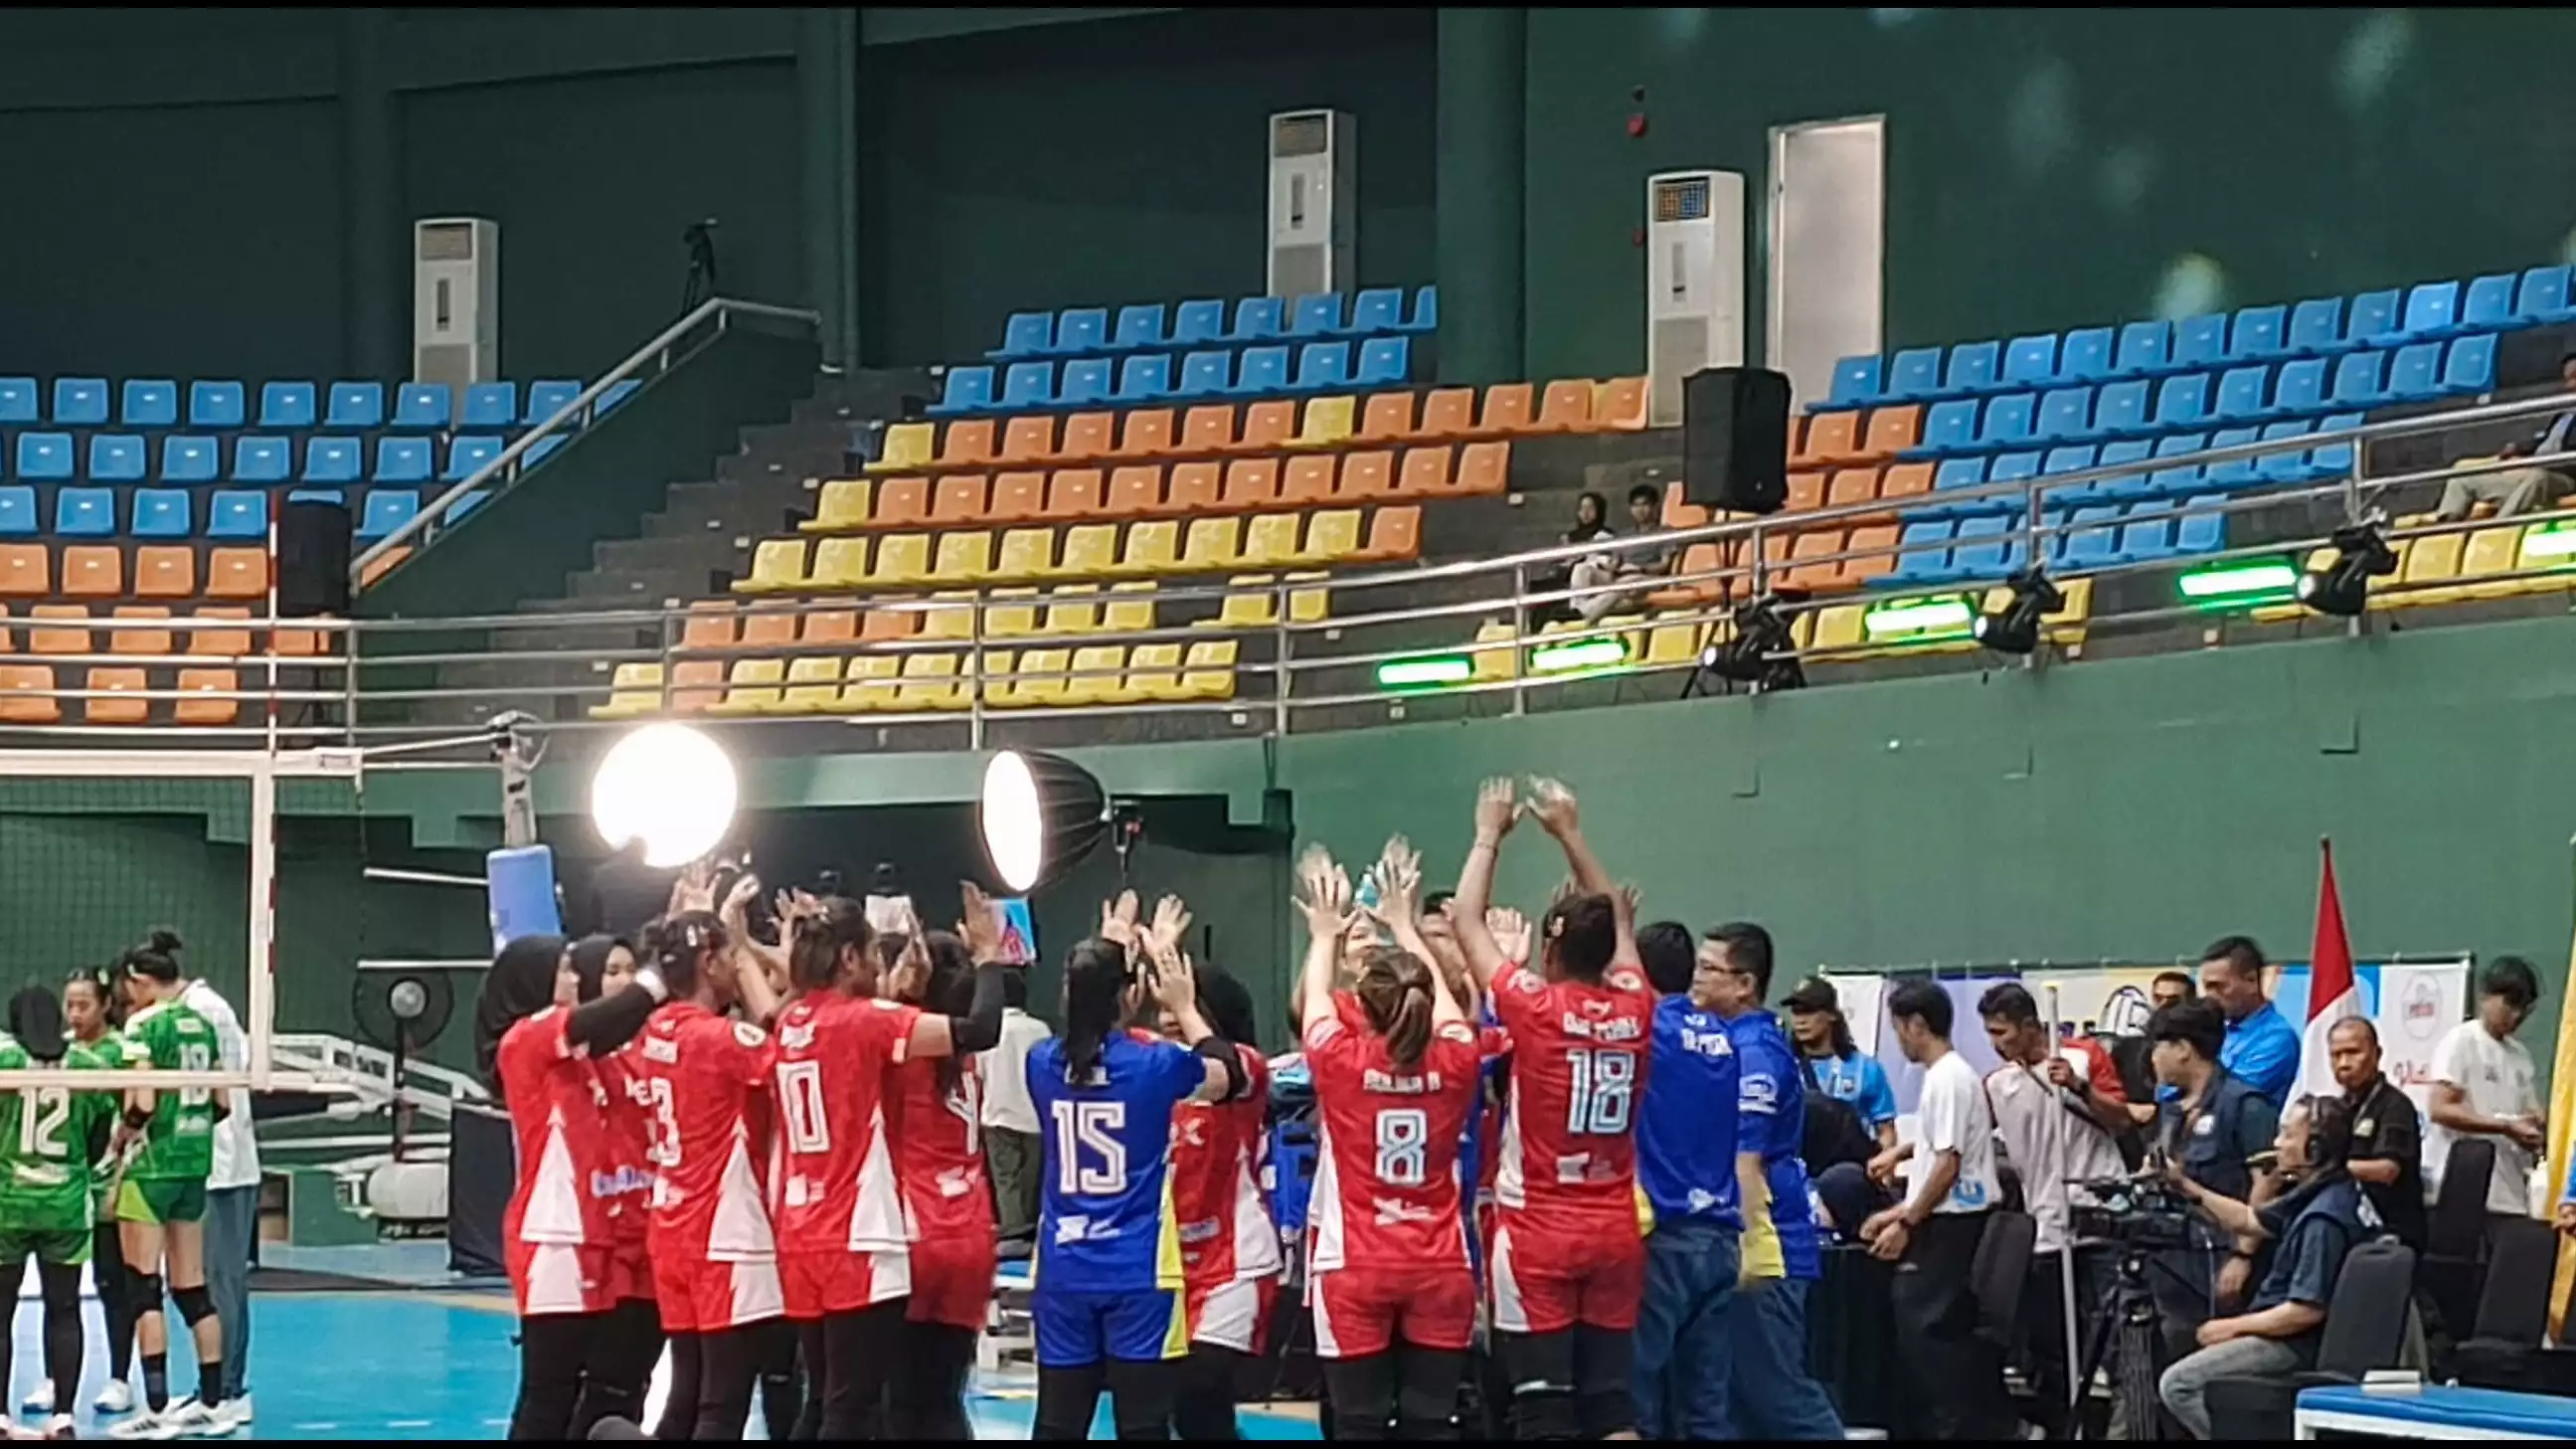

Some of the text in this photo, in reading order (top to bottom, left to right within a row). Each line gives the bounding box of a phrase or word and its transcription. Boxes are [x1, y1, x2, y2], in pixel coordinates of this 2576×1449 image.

[19, 1086, 71, 1157] 12
[1566, 1047, 1635, 1135] 18
[1051, 1099, 1128, 1194] 15
[1375, 1107, 1428, 1185] 8
